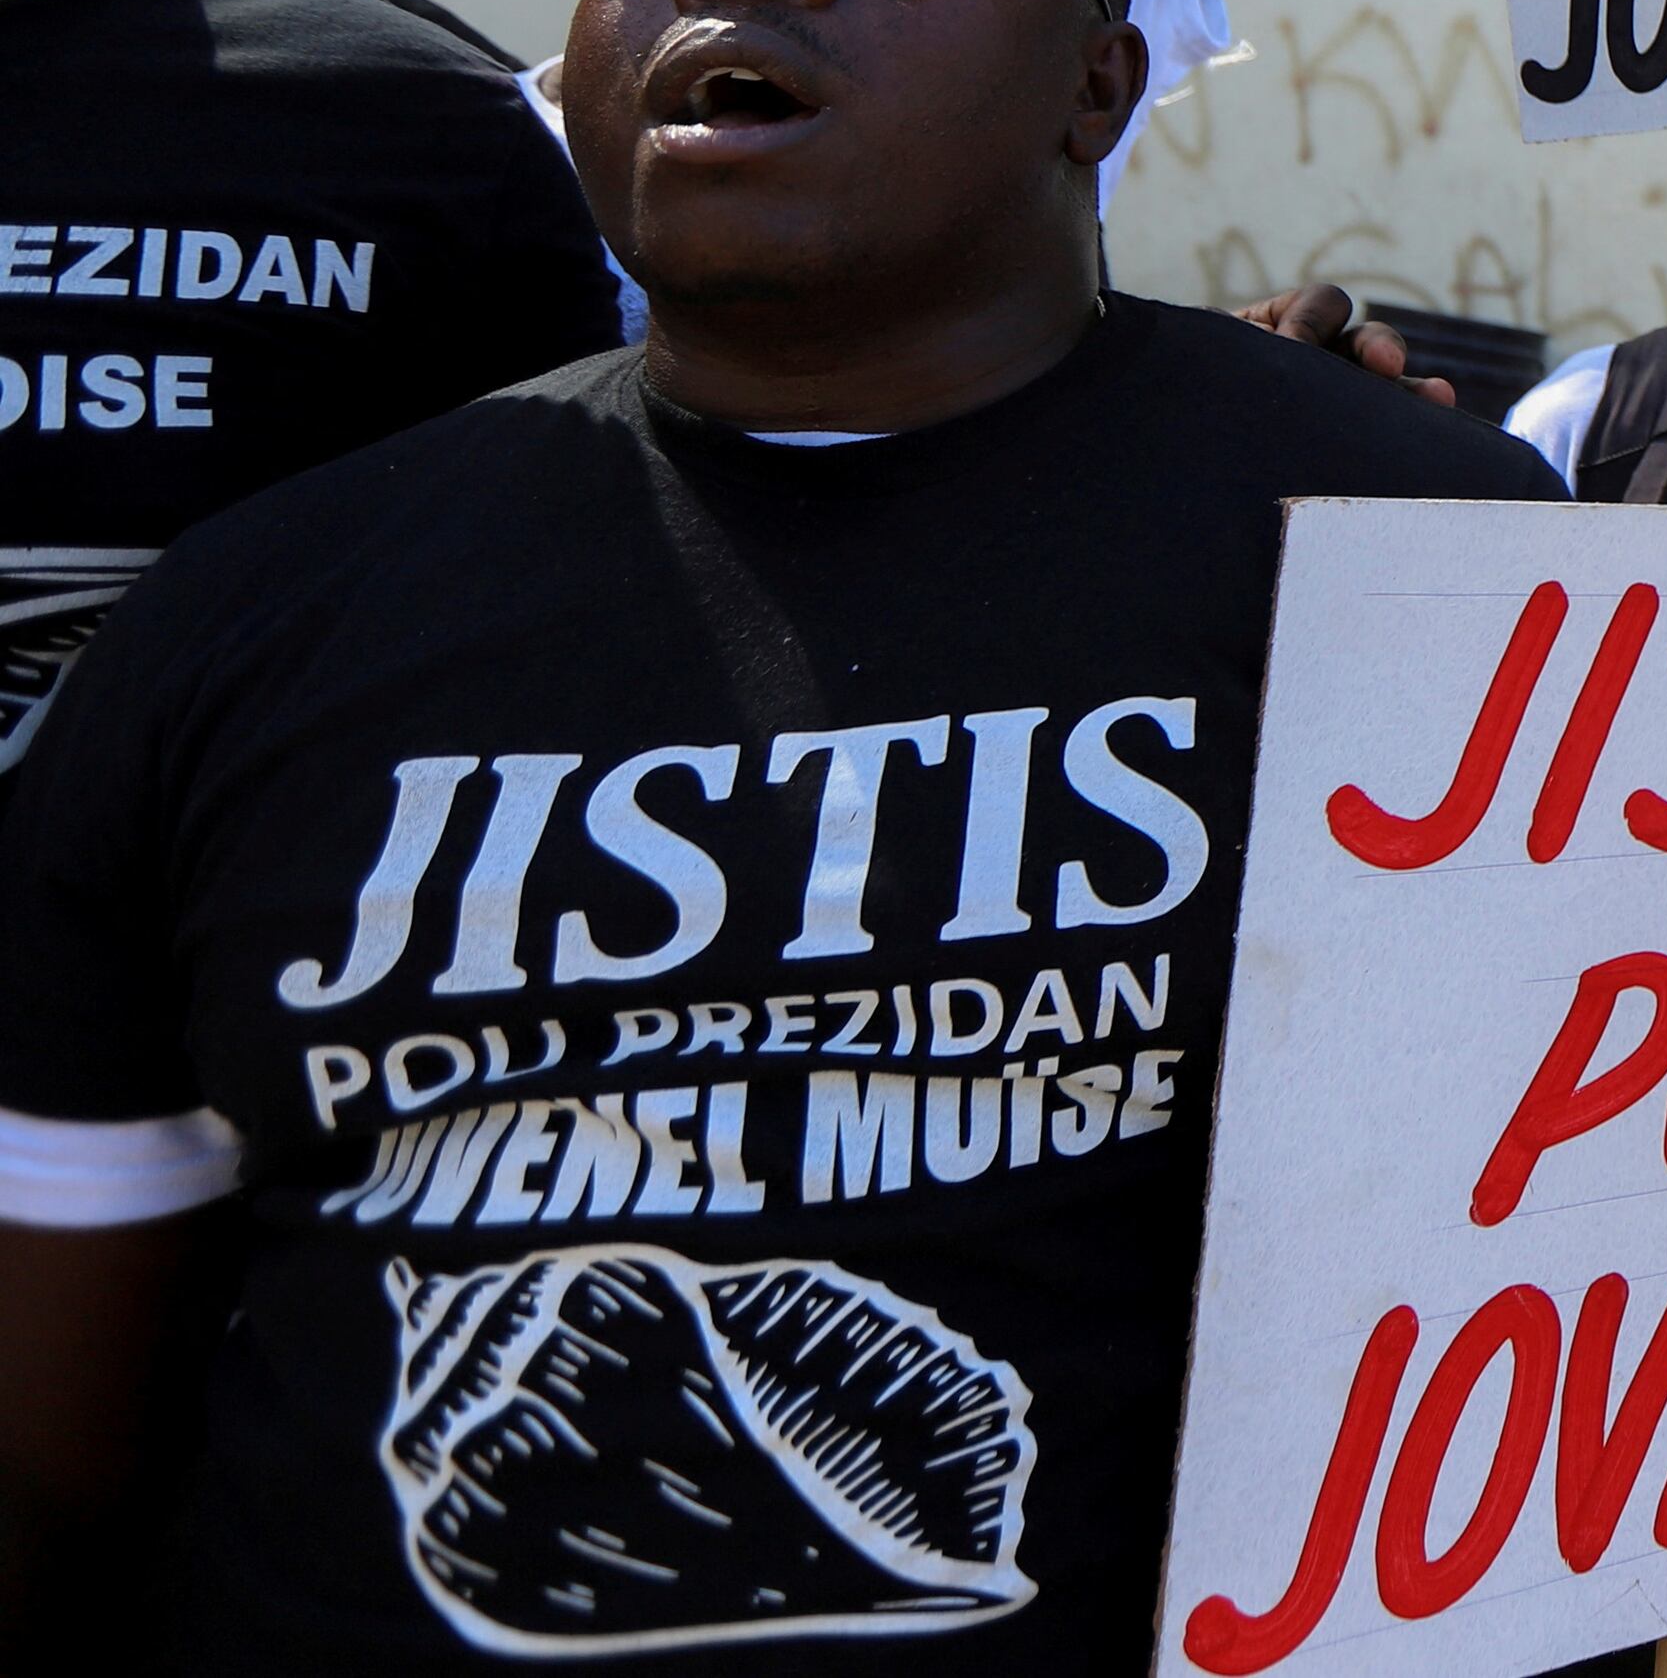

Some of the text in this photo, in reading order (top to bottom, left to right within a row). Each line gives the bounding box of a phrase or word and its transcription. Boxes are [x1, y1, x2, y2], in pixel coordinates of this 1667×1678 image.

[278, 696, 1210, 1010] JISTIS
[306, 952, 1171, 1132] POU PREZIDAN
